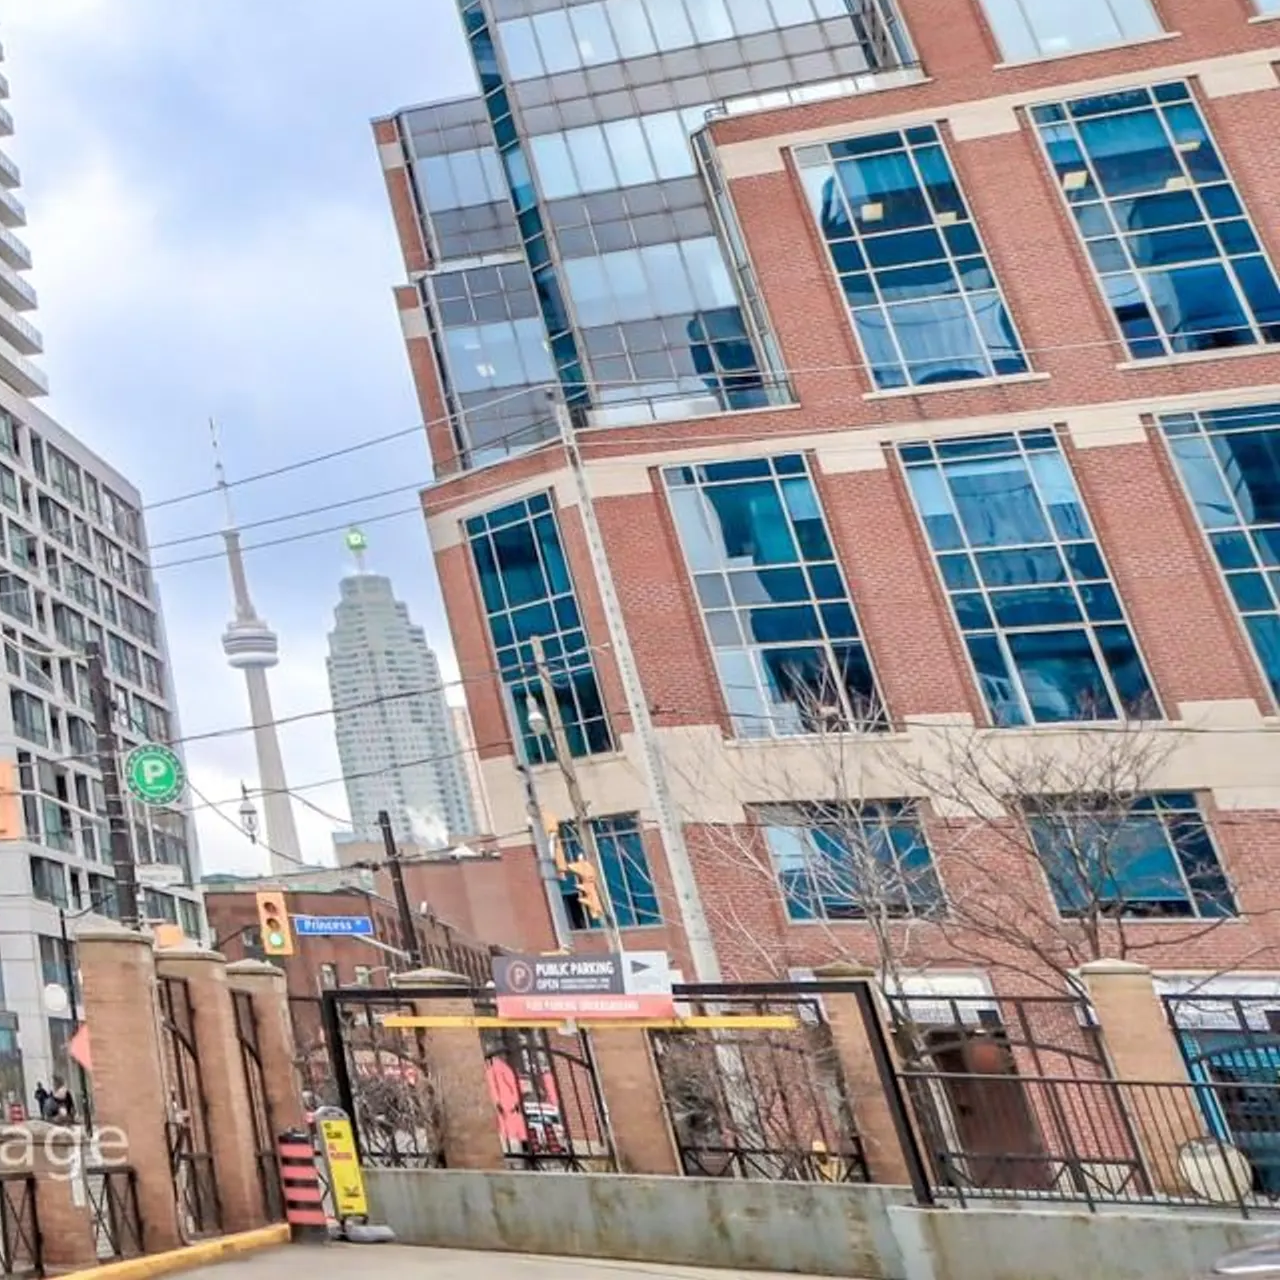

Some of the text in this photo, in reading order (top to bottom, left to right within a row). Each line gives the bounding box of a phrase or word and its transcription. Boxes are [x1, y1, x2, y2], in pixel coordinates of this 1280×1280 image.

[143, 760, 167, 785] P
[304, 919, 353, 931] Princess
[536, 961, 615, 977] PUBLIC PARKING
